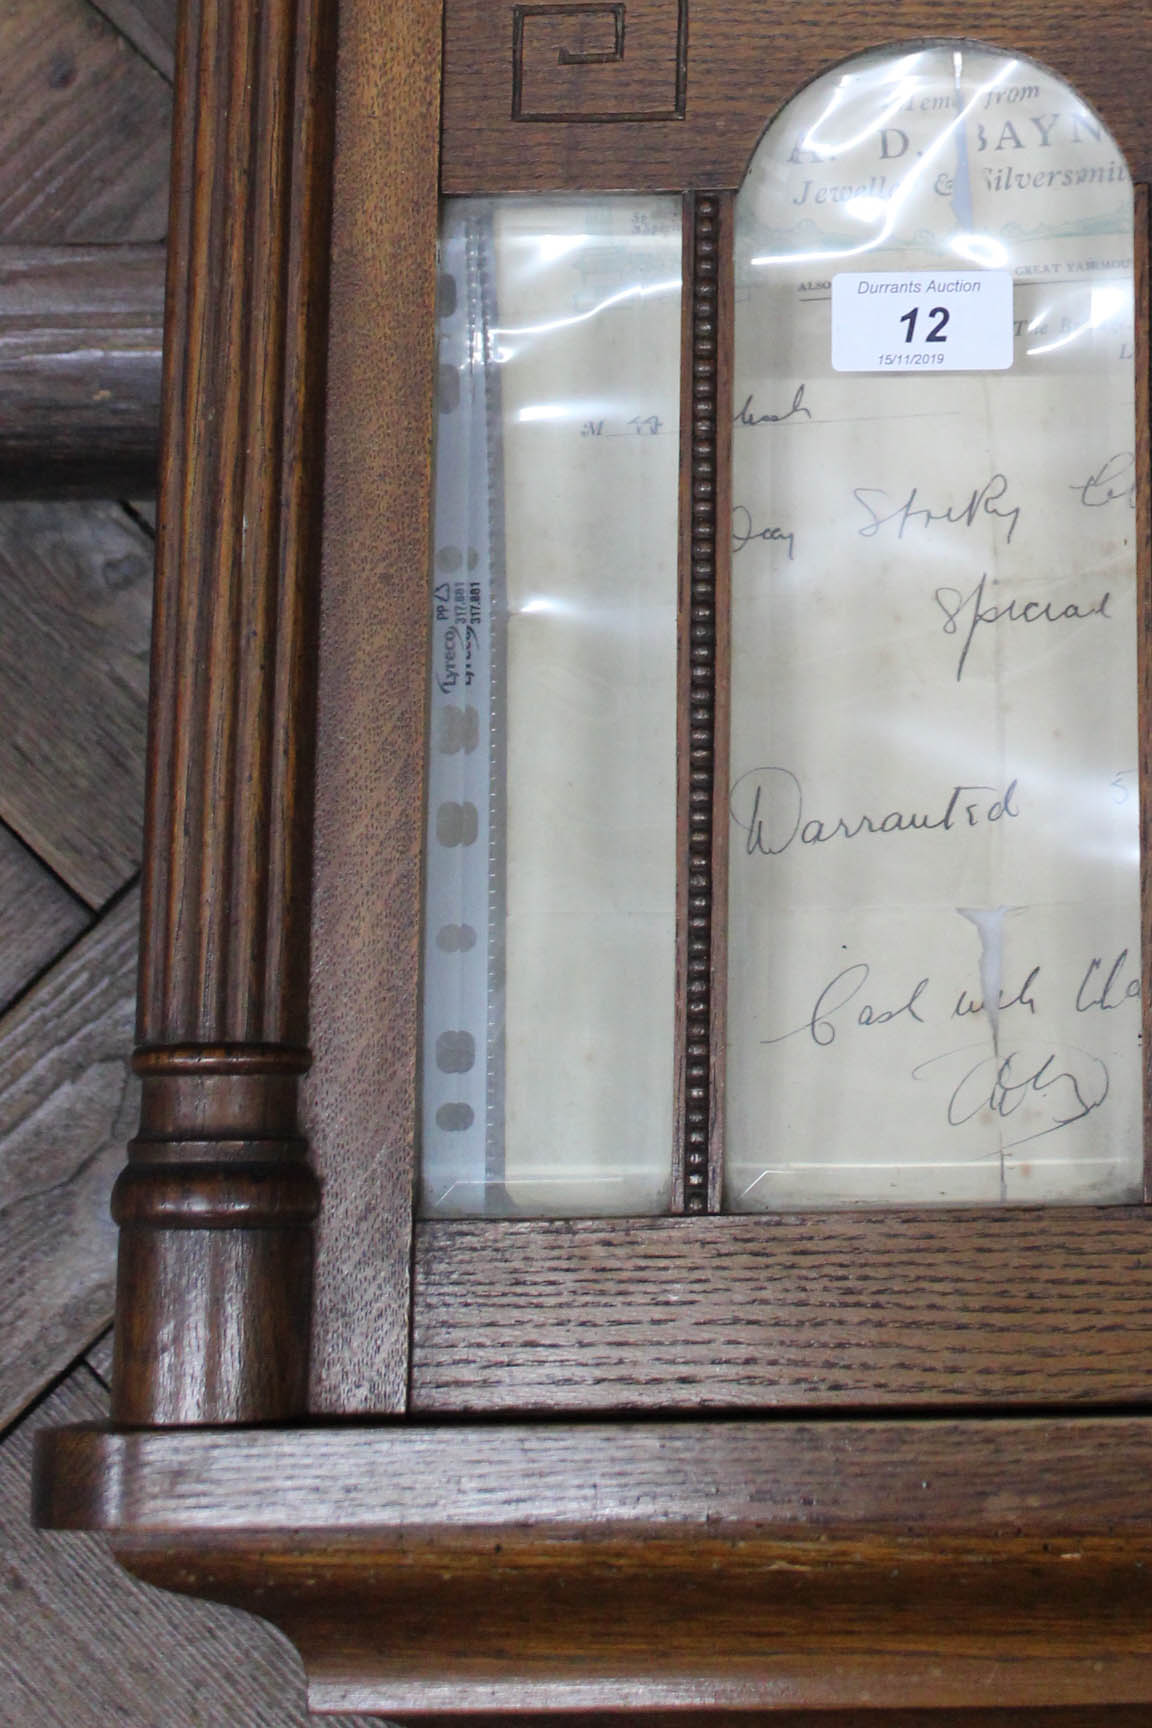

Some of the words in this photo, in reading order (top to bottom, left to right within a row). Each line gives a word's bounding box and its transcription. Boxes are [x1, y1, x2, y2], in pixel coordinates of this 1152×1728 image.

[857, 279, 923, 296] Durrants
[925, 278, 982, 295] Auction
[899, 306, 951, 344] 12
[877, 353, 945, 367] 15/11/2019
